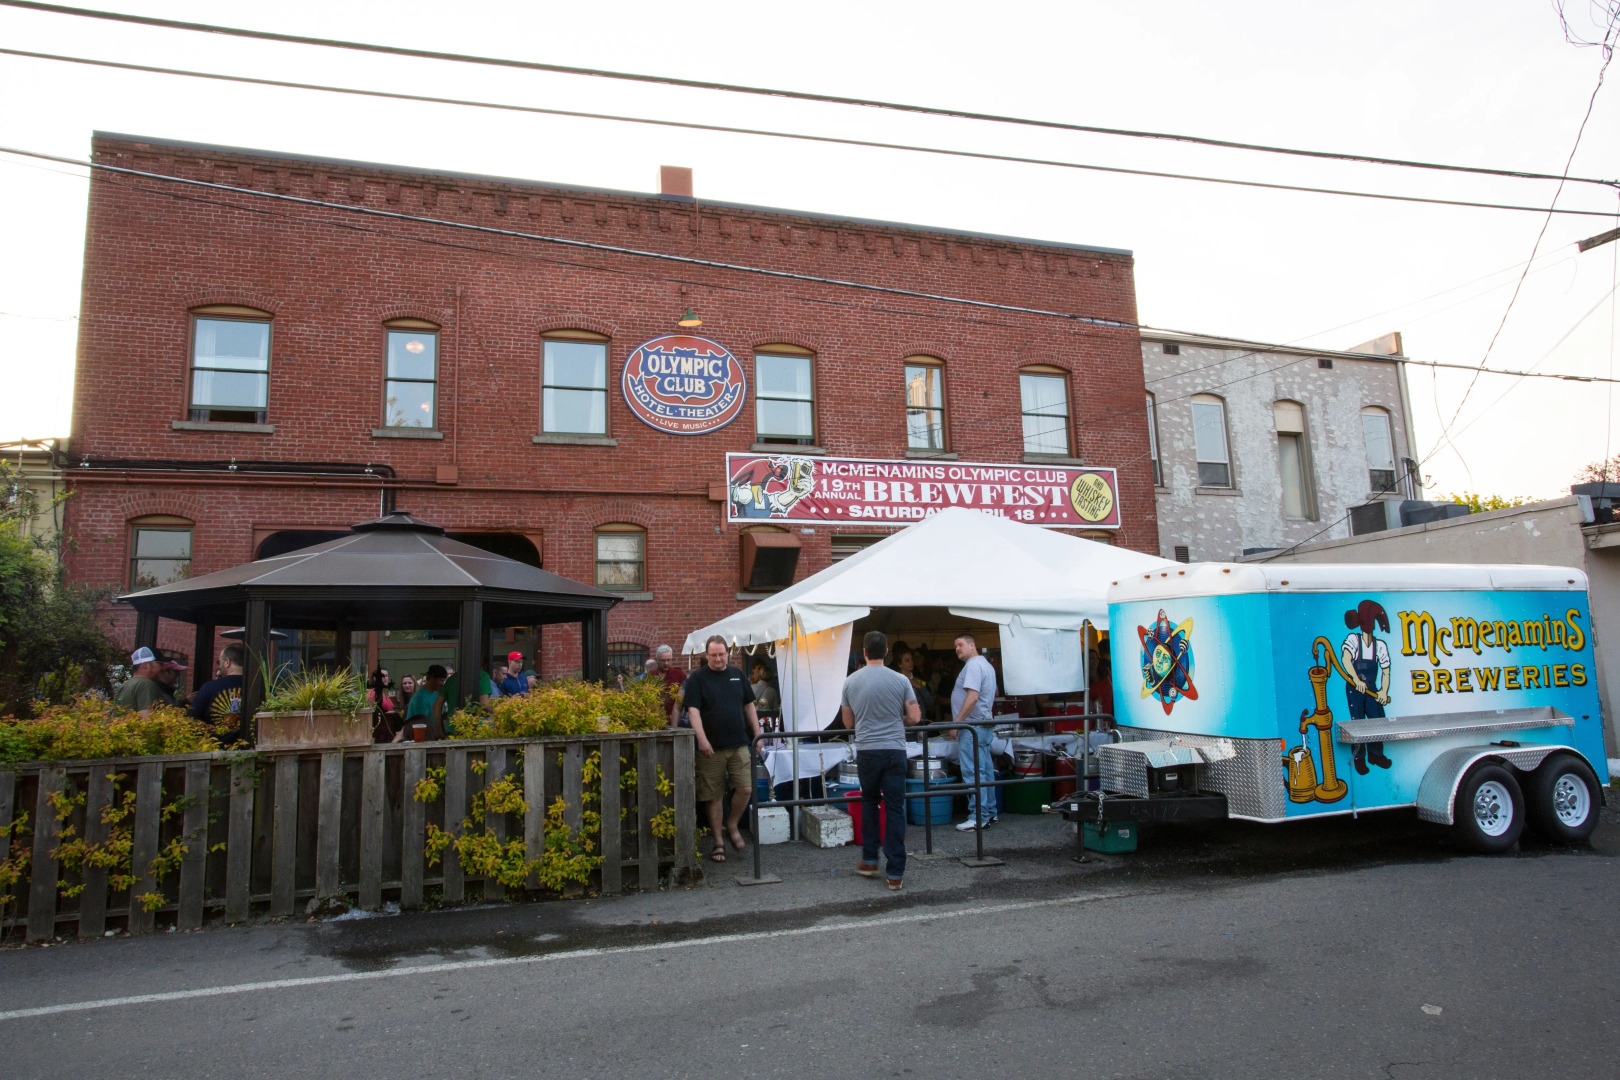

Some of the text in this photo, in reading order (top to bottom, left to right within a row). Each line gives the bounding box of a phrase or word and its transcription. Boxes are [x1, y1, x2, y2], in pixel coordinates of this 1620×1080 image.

[648, 354, 722, 377] OLYMPIC
[664, 376, 706, 394] CLUB
[634, 384, 734, 418] HOTEL THEATER
[659, 418, 708, 430] LIVE MUSIC
[948, 467, 1022, 482] OLYMPIC
[1024, 470, 1067, 483] CLUB
[820, 478, 860, 492] 19TH
[862, 480, 1068, 506] BREWFEST
[1093, 478, 1104, 491] AND
[814, 491, 861, 500] ANNUAL
[1076, 479, 1111, 511] WHISKEY
[1014, 509, 1035, 521] 18
[1074, 493, 1101, 519] TASTING
[1410, 663, 1588, 694] BREWERIES
